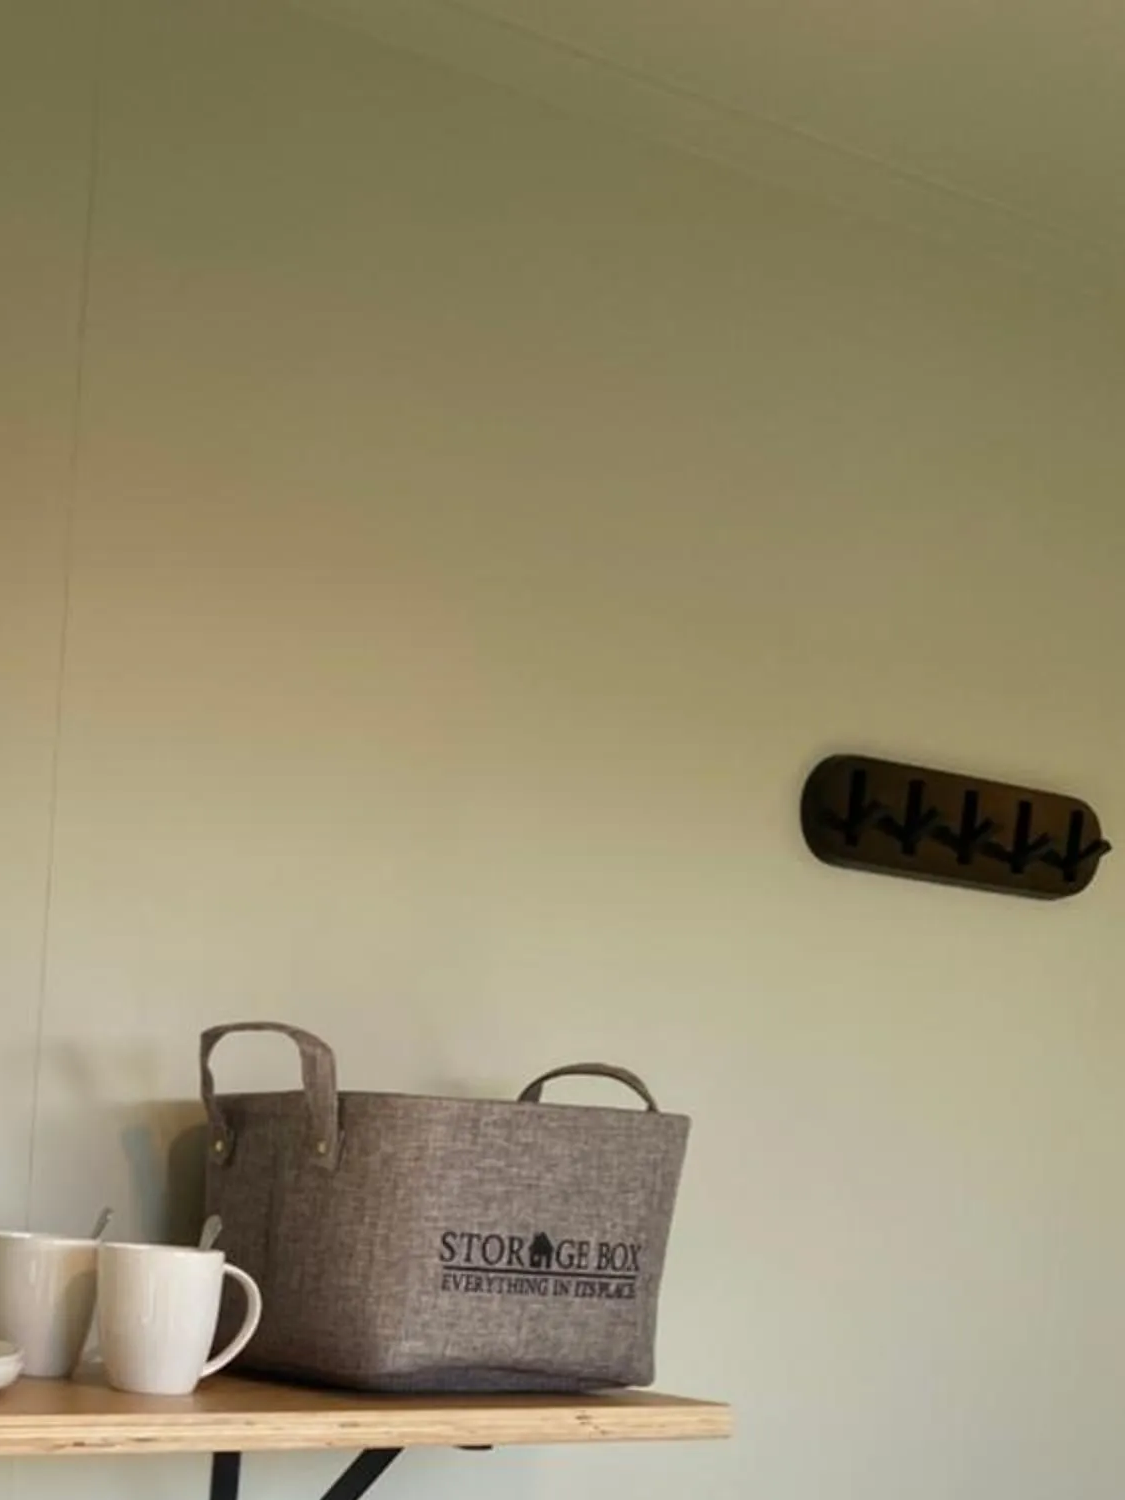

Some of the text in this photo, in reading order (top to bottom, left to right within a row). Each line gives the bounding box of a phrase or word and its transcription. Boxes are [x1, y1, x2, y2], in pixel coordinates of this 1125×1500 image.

[596, 1242, 642, 1272] BOX
[441, 1273, 549, 1297] EVERYTHING
[553, 1279, 572, 1297] IN
